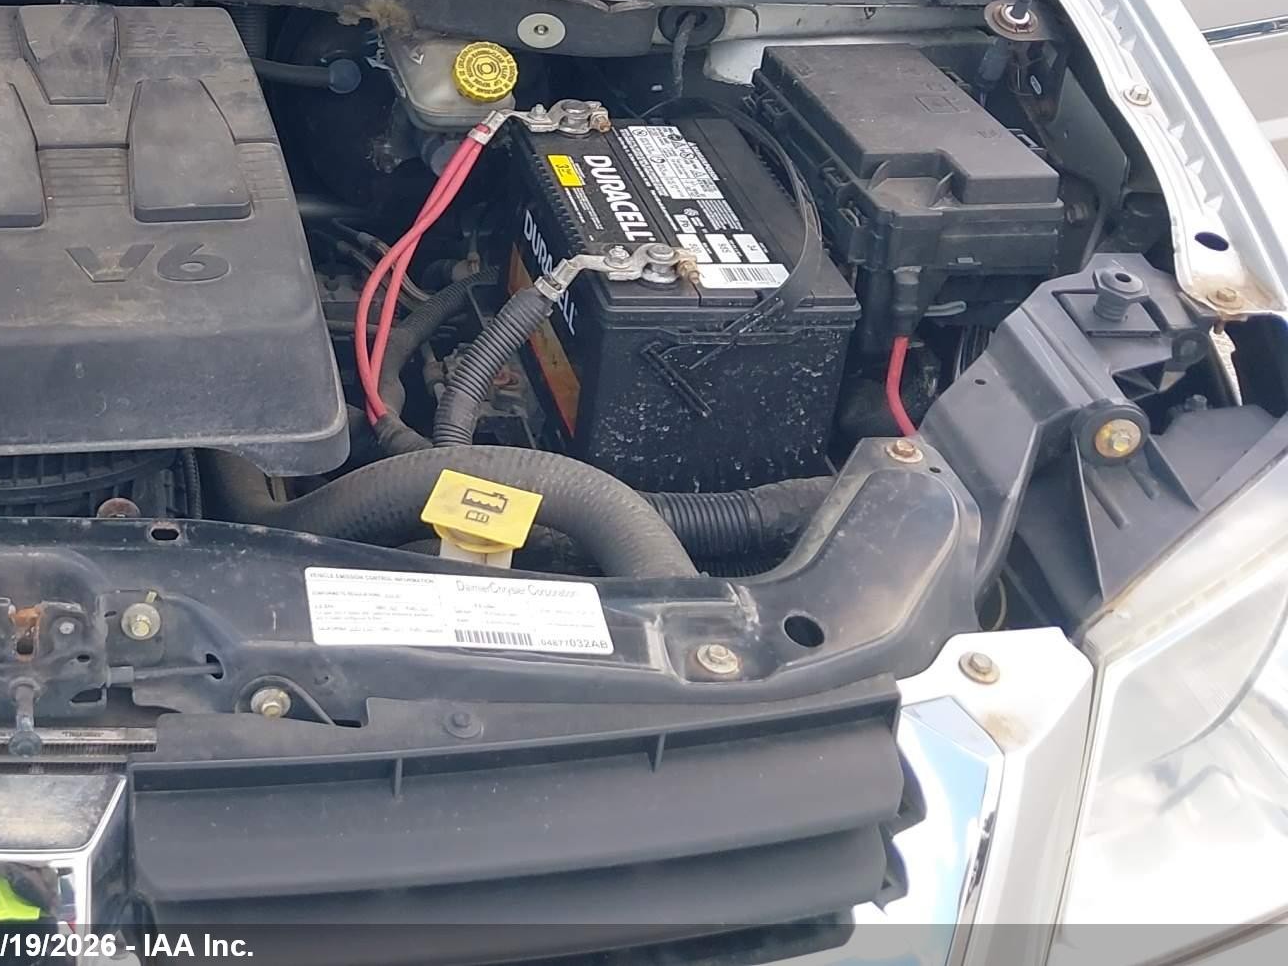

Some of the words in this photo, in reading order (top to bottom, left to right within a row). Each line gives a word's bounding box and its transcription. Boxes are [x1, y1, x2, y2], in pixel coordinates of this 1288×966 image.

[583, 155, 650, 242] DURACELL
[66, 242, 231, 283] V6
[524, 210, 575, 336] DURALL
